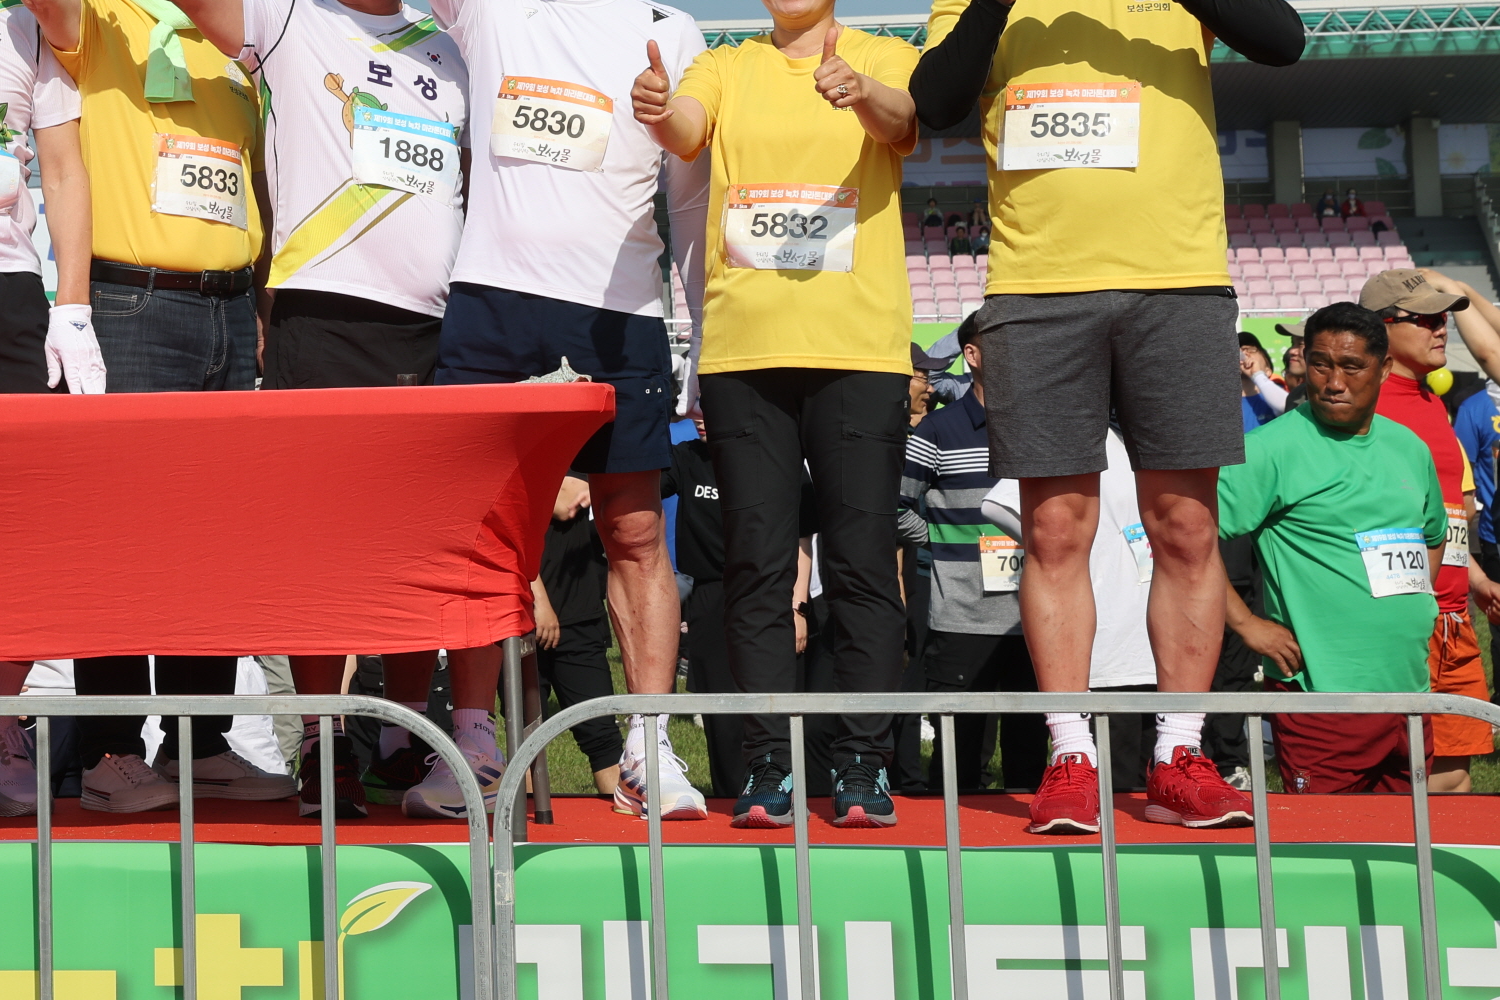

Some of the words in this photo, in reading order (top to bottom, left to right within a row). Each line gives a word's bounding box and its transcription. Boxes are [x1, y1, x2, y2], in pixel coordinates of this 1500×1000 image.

[1127, 3, 1171, 12] 보성군의회
[516, 81, 535, 92] 제19회
[536, 84, 550, 94] 보성
[549, 86, 563, 96] 녹차
[563, 88, 597, 103] 마라톤대회
[1026, 90, 1048, 98] 제19회
[1049, 89, 1064, 98] 보성
[1065, 89, 1080, 98] 녹차
[1081, 89, 1118, 98] 마라톤대회
[374, 114, 394, 125] 제19회
[394, 118, 407, 128] 보성
[408, 121, 421, 131] 녹차
[421, 123, 452, 138] 마라톤대회
[512, 105, 586, 139] 5830
[1030, 112, 1111, 138] 5835
[176, 140, 196, 150] 제19회
[197, 143, 210, 152] 보성
[210, 145, 222, 154] 녹차
[222, 147, 241, 160] 마라톤대
[379, 137, 444, 172] 1888
[535, 143, 571, 163] 보성몰
[1064, 147, 1102, 165] 보성몰
[180, 163, 239, 197] 5833
[404, 174, 435, 195] 보성몰
[749, 190, 770, 198] 제19회
[770, 190, 784, 198] 보성
[785, 190, 800, 198] 녹차
[800, 191, 835, 201] 마라톤대회
[207, 201, 233, 220] 보성몰
[750, 212, 829, 240] 5832
[781, 249, 819, 267] 보성몰
[694, 484, 720, 500] DES
[1381, 550, 1425, 571] 7120
